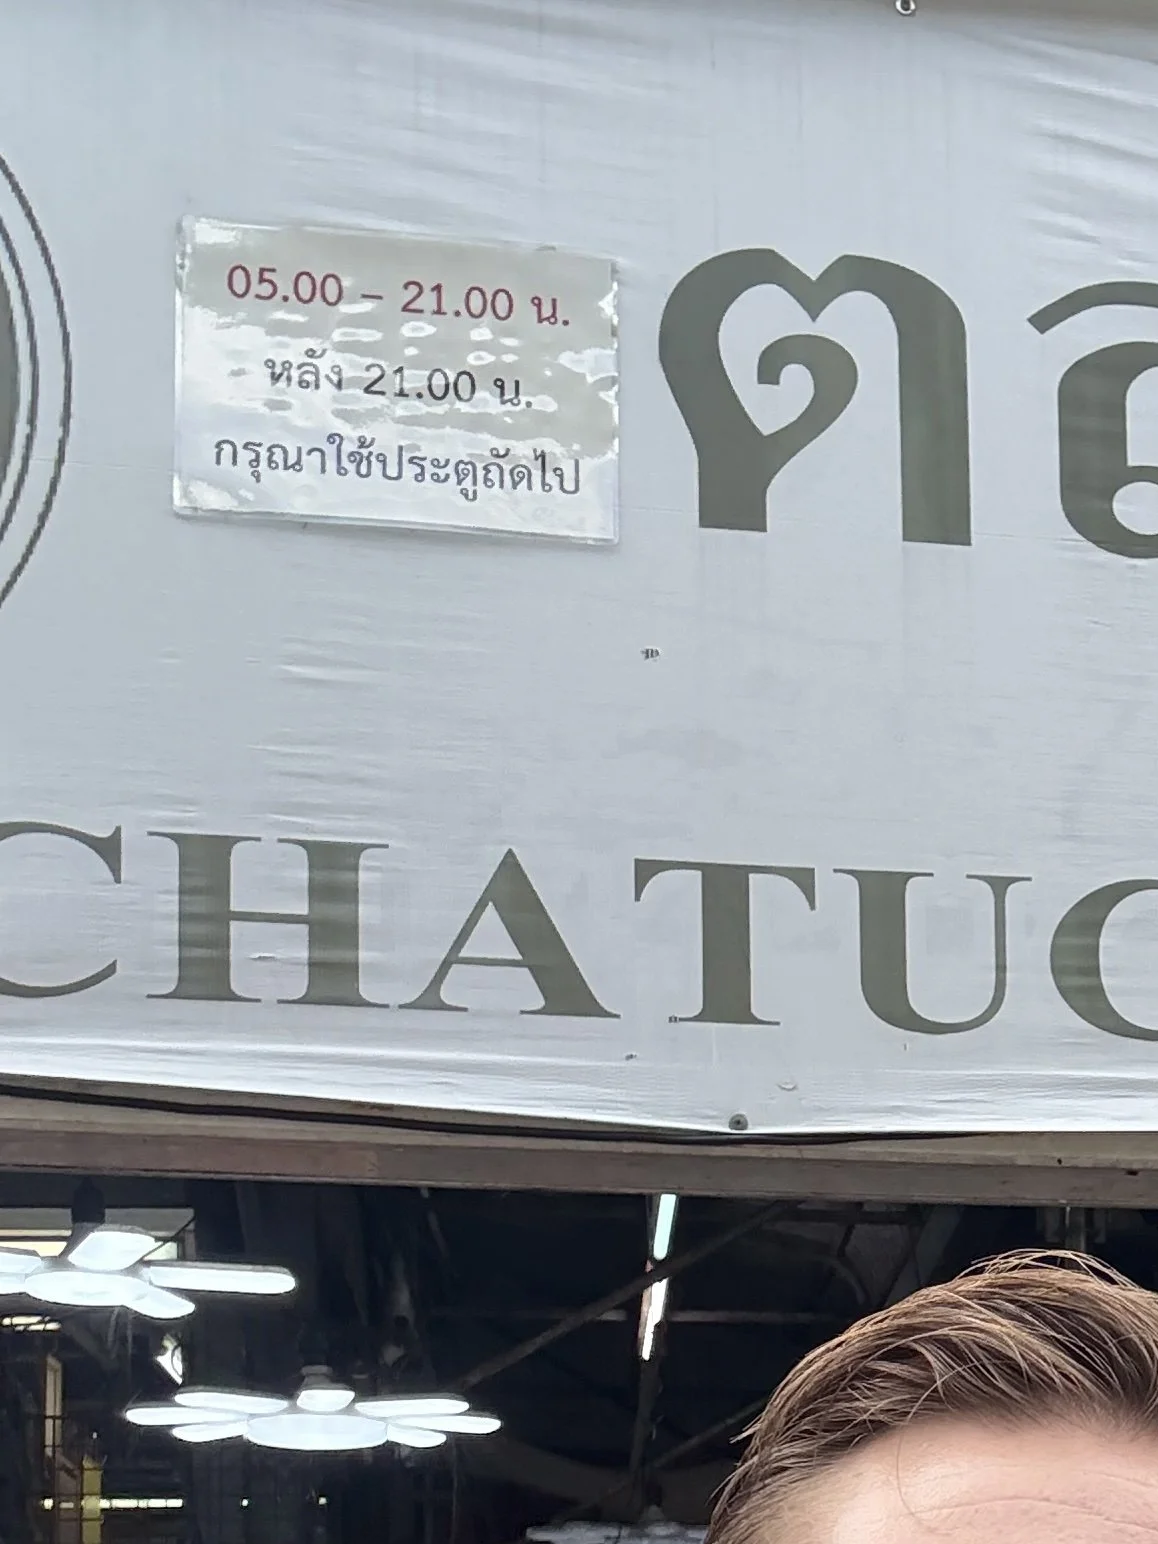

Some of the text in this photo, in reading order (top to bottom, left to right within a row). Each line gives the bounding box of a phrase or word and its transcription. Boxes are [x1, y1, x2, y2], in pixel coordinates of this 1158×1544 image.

[226, 263, 345, 307] 05.00
[400, 279, 514, 321] 21.00
[530, 294, 571, 327] น.
[263, 347, 533, 409] หลัง 21.00 น.
[213, 431, 581, 503] กรุณาใช้ประตูถัดไป
